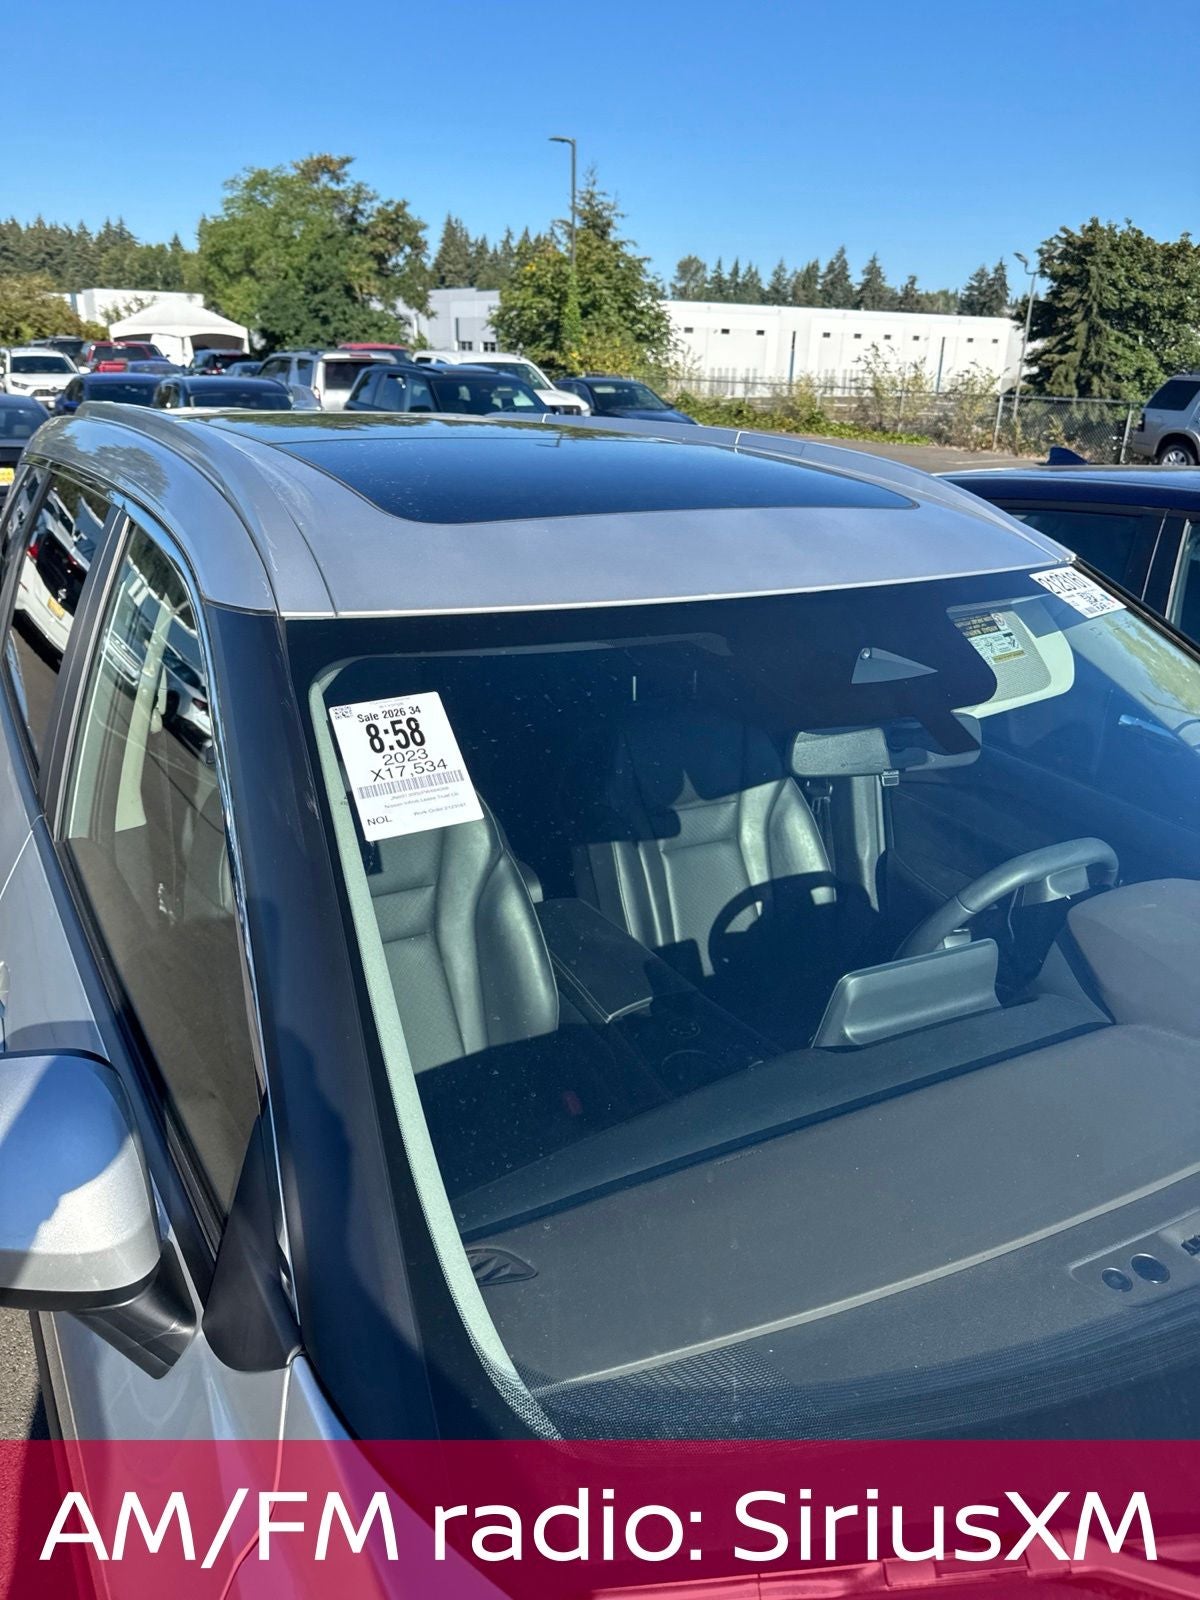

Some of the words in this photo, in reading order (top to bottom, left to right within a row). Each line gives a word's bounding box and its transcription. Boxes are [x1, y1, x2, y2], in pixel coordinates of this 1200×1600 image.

[356, 711, 380, 723] Sale
[381, 707, 407, 720] 2026
[408, 705, 422, 715] 34
[365, 716, 426, 754] 8:58
[382, 748, 429, 766] 2023
[370, 758, 448, 782] X17,534
[366, 815, 393, 827] NOL
